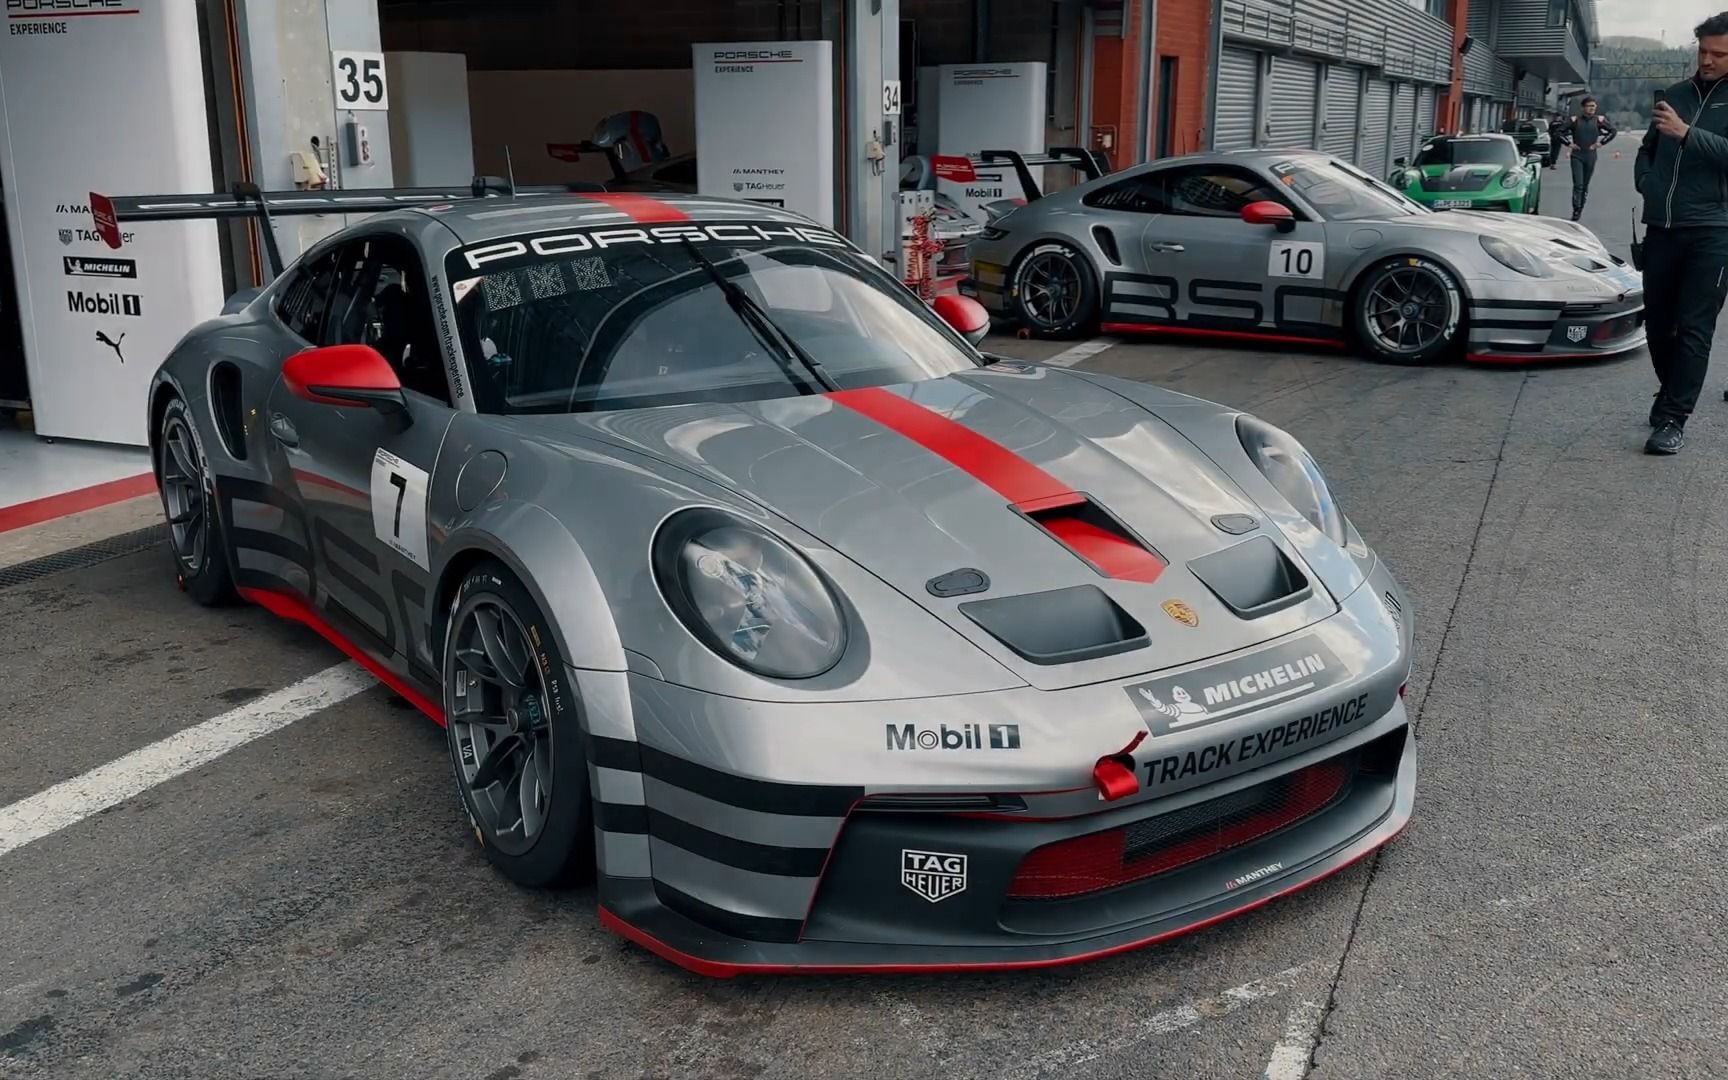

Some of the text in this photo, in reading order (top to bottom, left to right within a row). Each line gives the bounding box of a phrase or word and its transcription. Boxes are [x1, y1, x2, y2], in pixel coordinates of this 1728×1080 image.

[10, 22, 67, 35] EXPERIENCE
[714, 50, 792, 59] PORSCHE
[338, 57, 383, 103] 35
[884, 85, 899, 112] 34
[965, 188, 992, 198] Mobil
[464, 224, 847, 269] PORSCHE
[83, 262, 130, 273] MICHELIN
[1280, 247, 1312, 275] 10
[67, 291, 138, 315] Mobil 1
[389, 471, 408, 538] 7
[1203, 653, 1326, 705] MICHELIN
[886, 723, 981, 750] Mobil
[1143, 693, 1369, 787] TRACK EXPERIENCE
[907, 853, 961, 873] TAG
[1235, 861, 1283, 885] MANTHEY
[906, 873, 962, 898] HEUER
